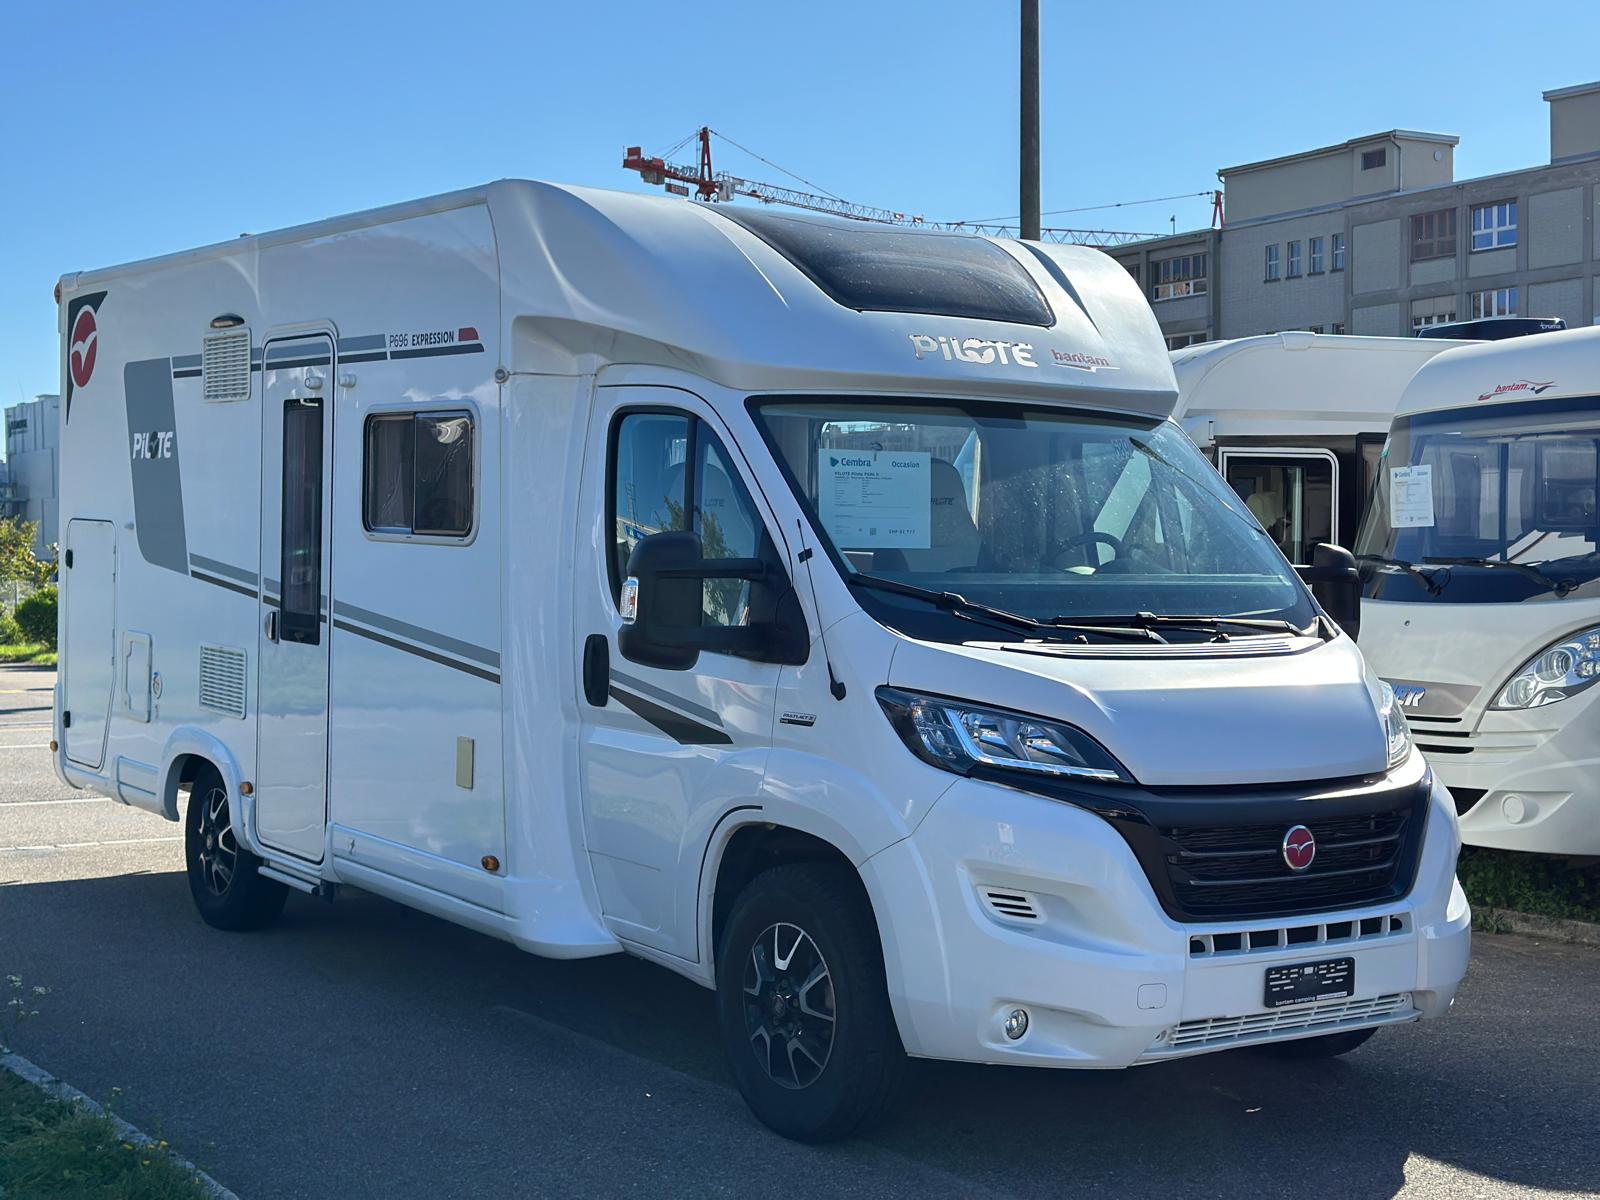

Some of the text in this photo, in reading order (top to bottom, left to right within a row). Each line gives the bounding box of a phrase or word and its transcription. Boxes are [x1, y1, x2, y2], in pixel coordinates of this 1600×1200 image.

[389, 330, 455, 348] P696 EXPRESSION
[1051, 348, 1111, 367] bantam
[1494, 381, 1528, 393] bantam
[841, 457, 920, 469] Cembra Occasion
